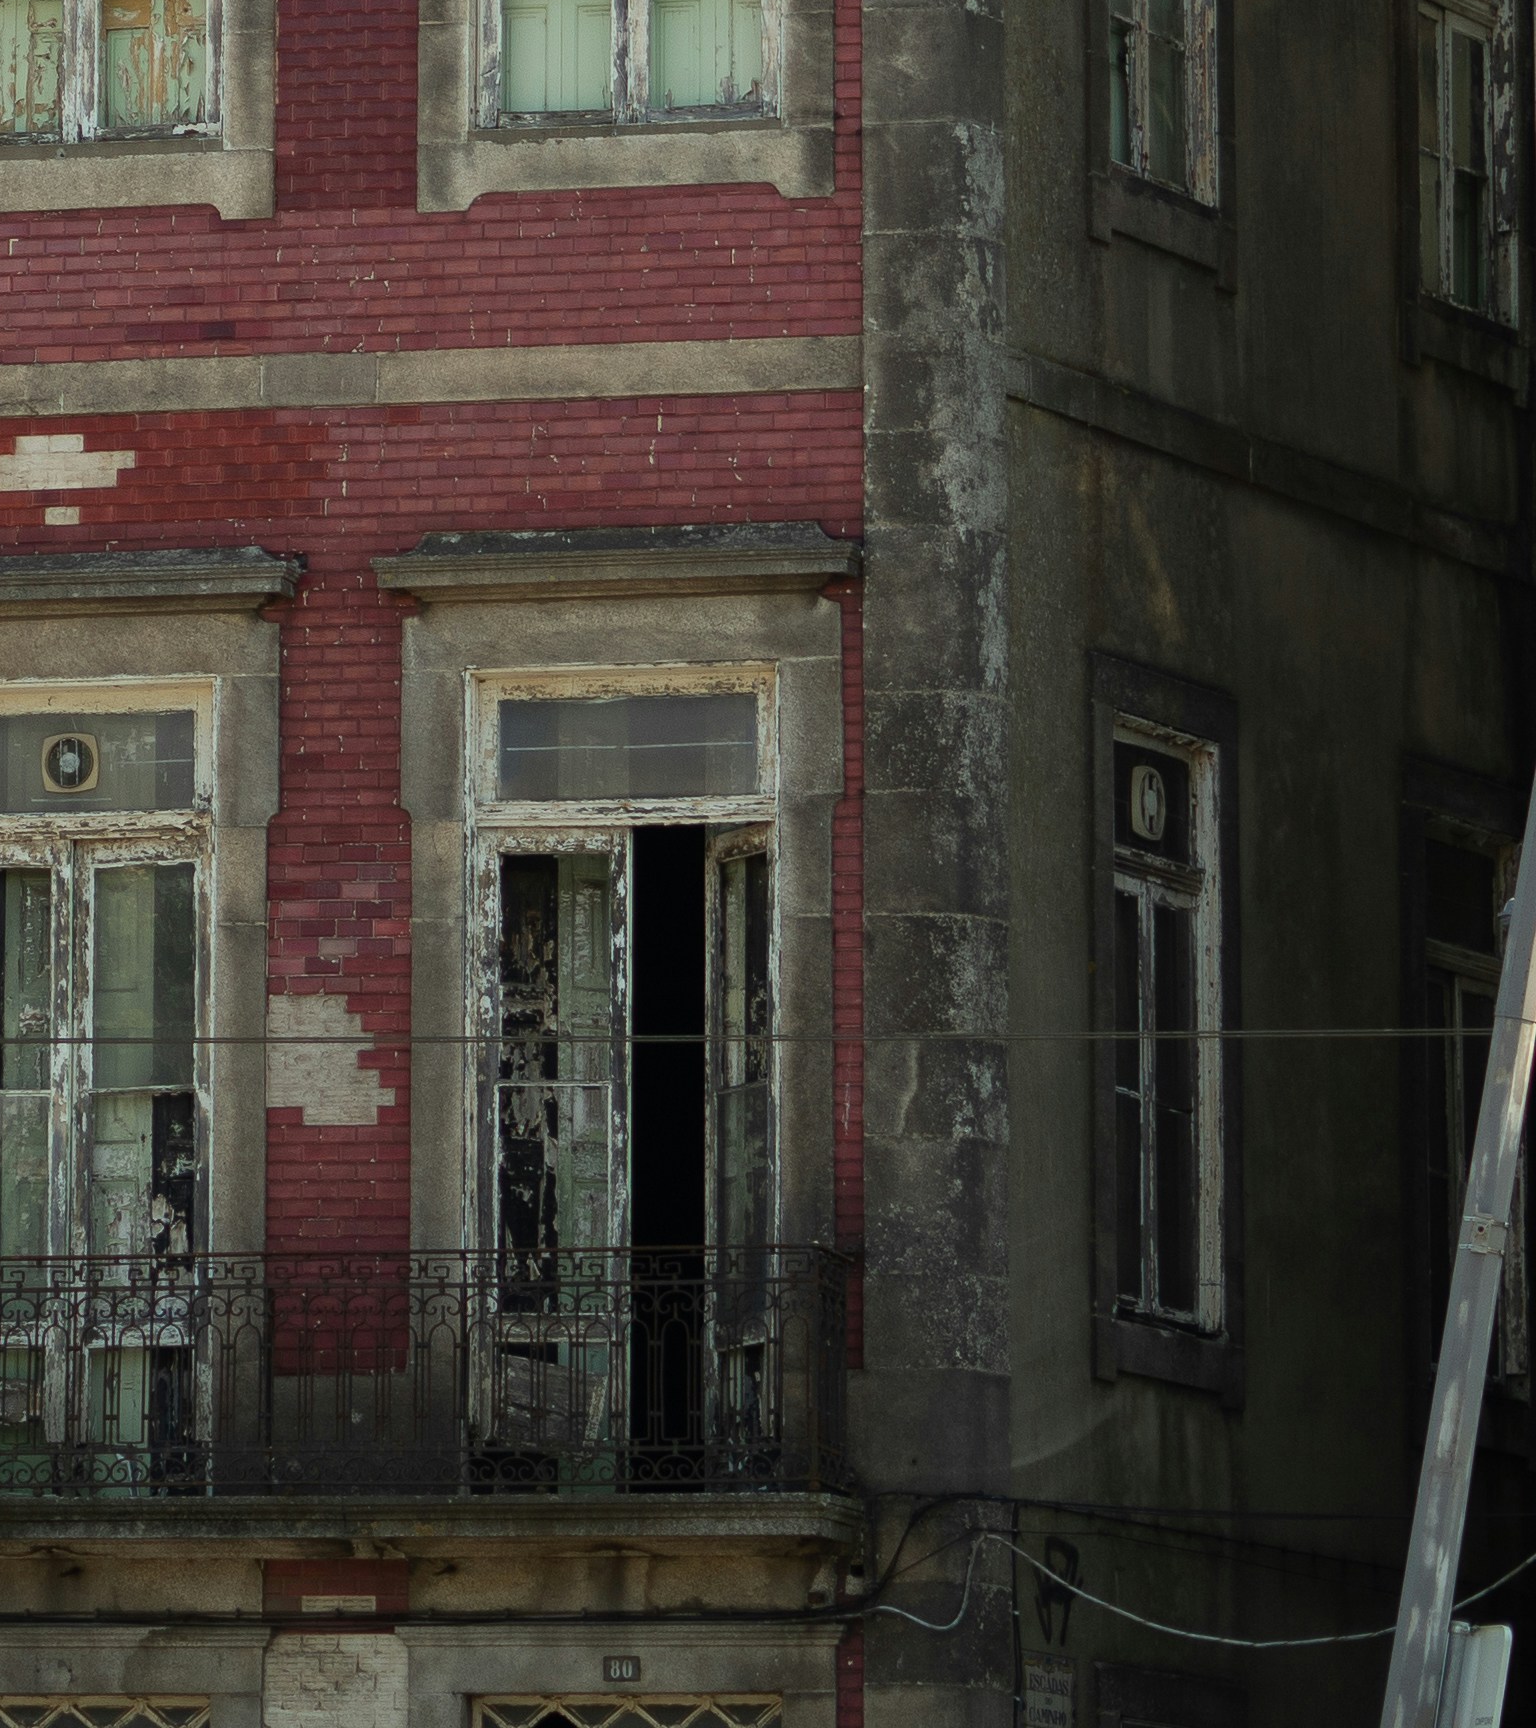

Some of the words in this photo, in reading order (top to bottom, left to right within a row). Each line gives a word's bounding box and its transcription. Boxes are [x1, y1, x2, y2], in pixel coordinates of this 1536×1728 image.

[610, 1659, 633, 1679] 80
[1029, 1673, 1069, 1696] ESCADAS
[1029, 1706, 1067, 1727] CAMINHO
